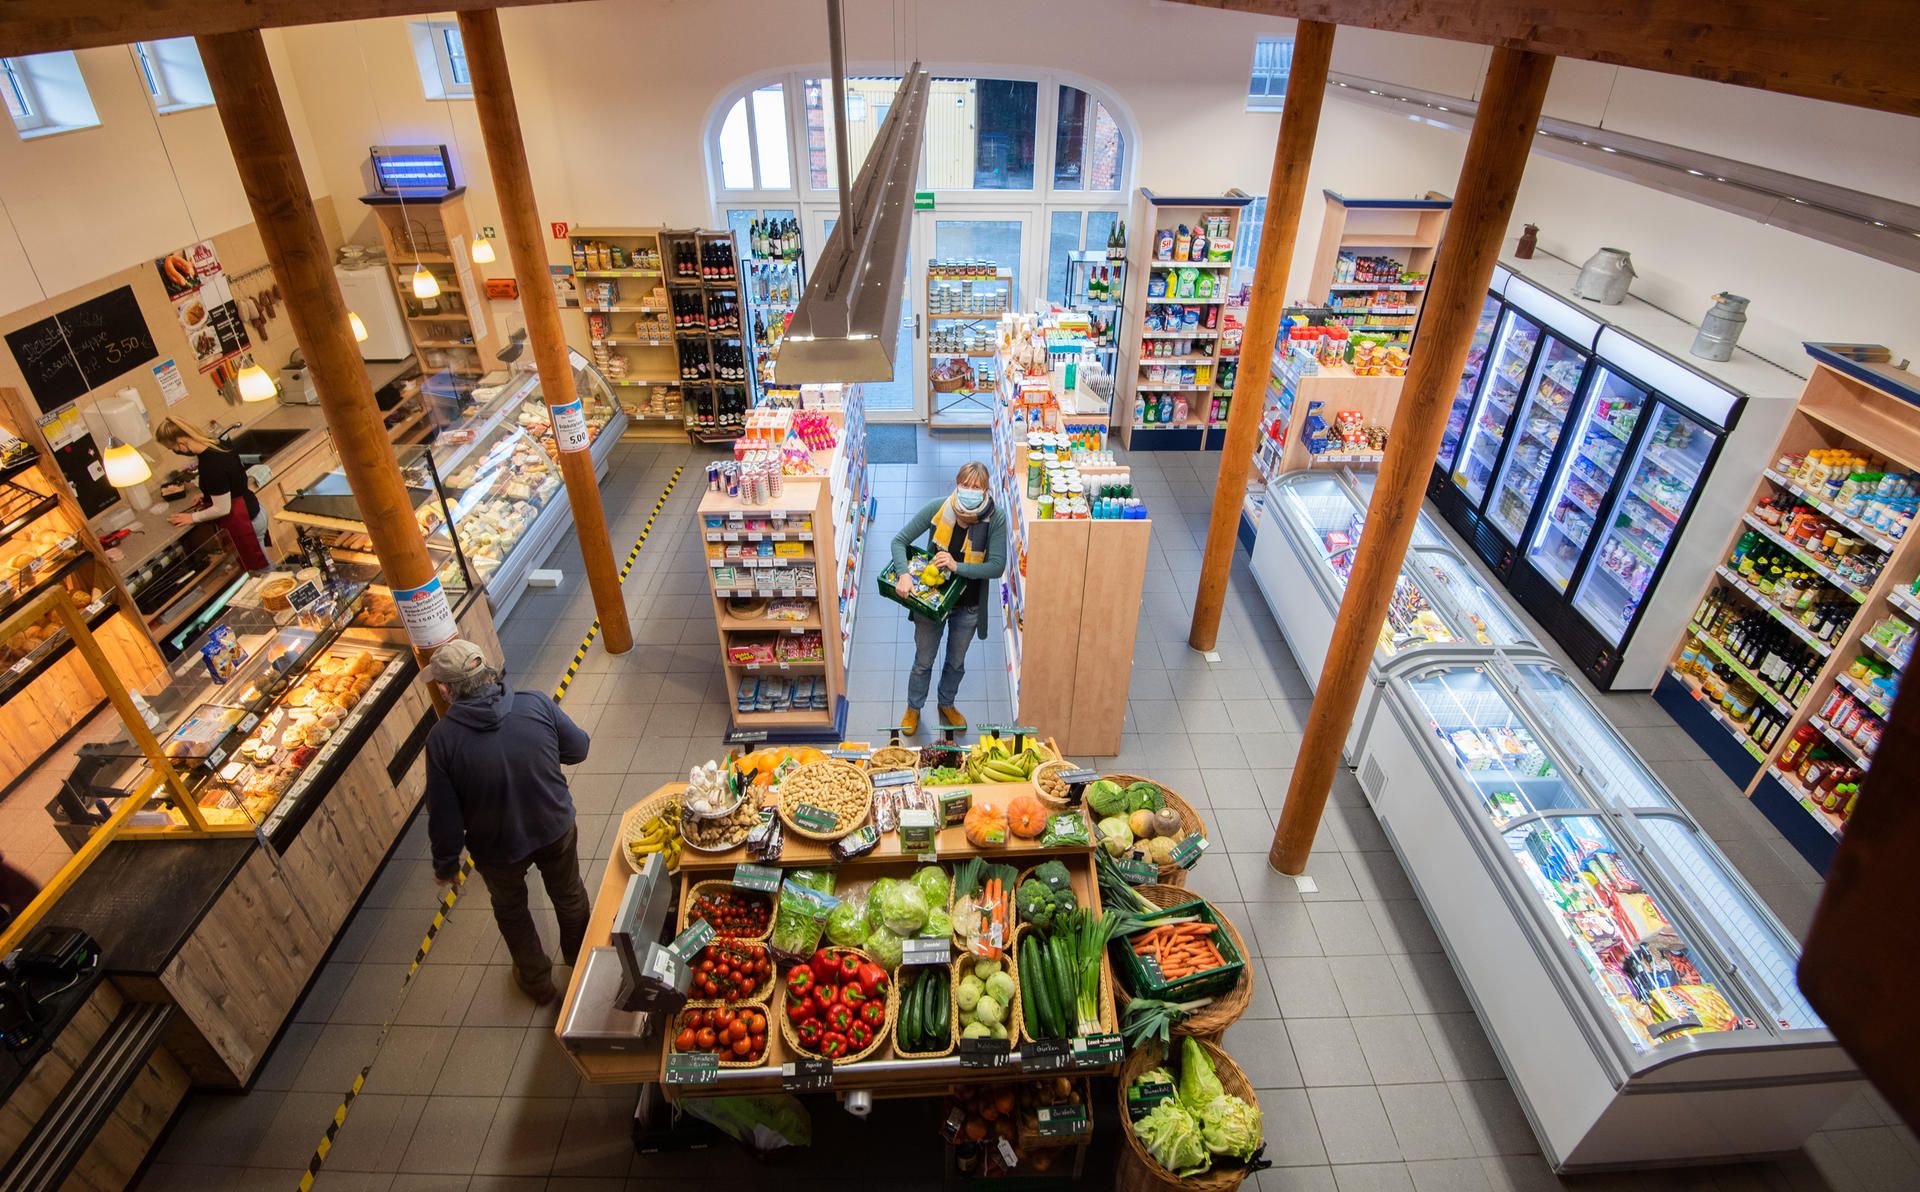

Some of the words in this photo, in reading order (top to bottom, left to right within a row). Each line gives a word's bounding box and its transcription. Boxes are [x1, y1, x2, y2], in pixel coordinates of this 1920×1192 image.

[569, 431, 586, 445] 5,00
[1036, 1044, 1060, 1053] Gurken
[689, 1055, 715, 1063] Tomaten
